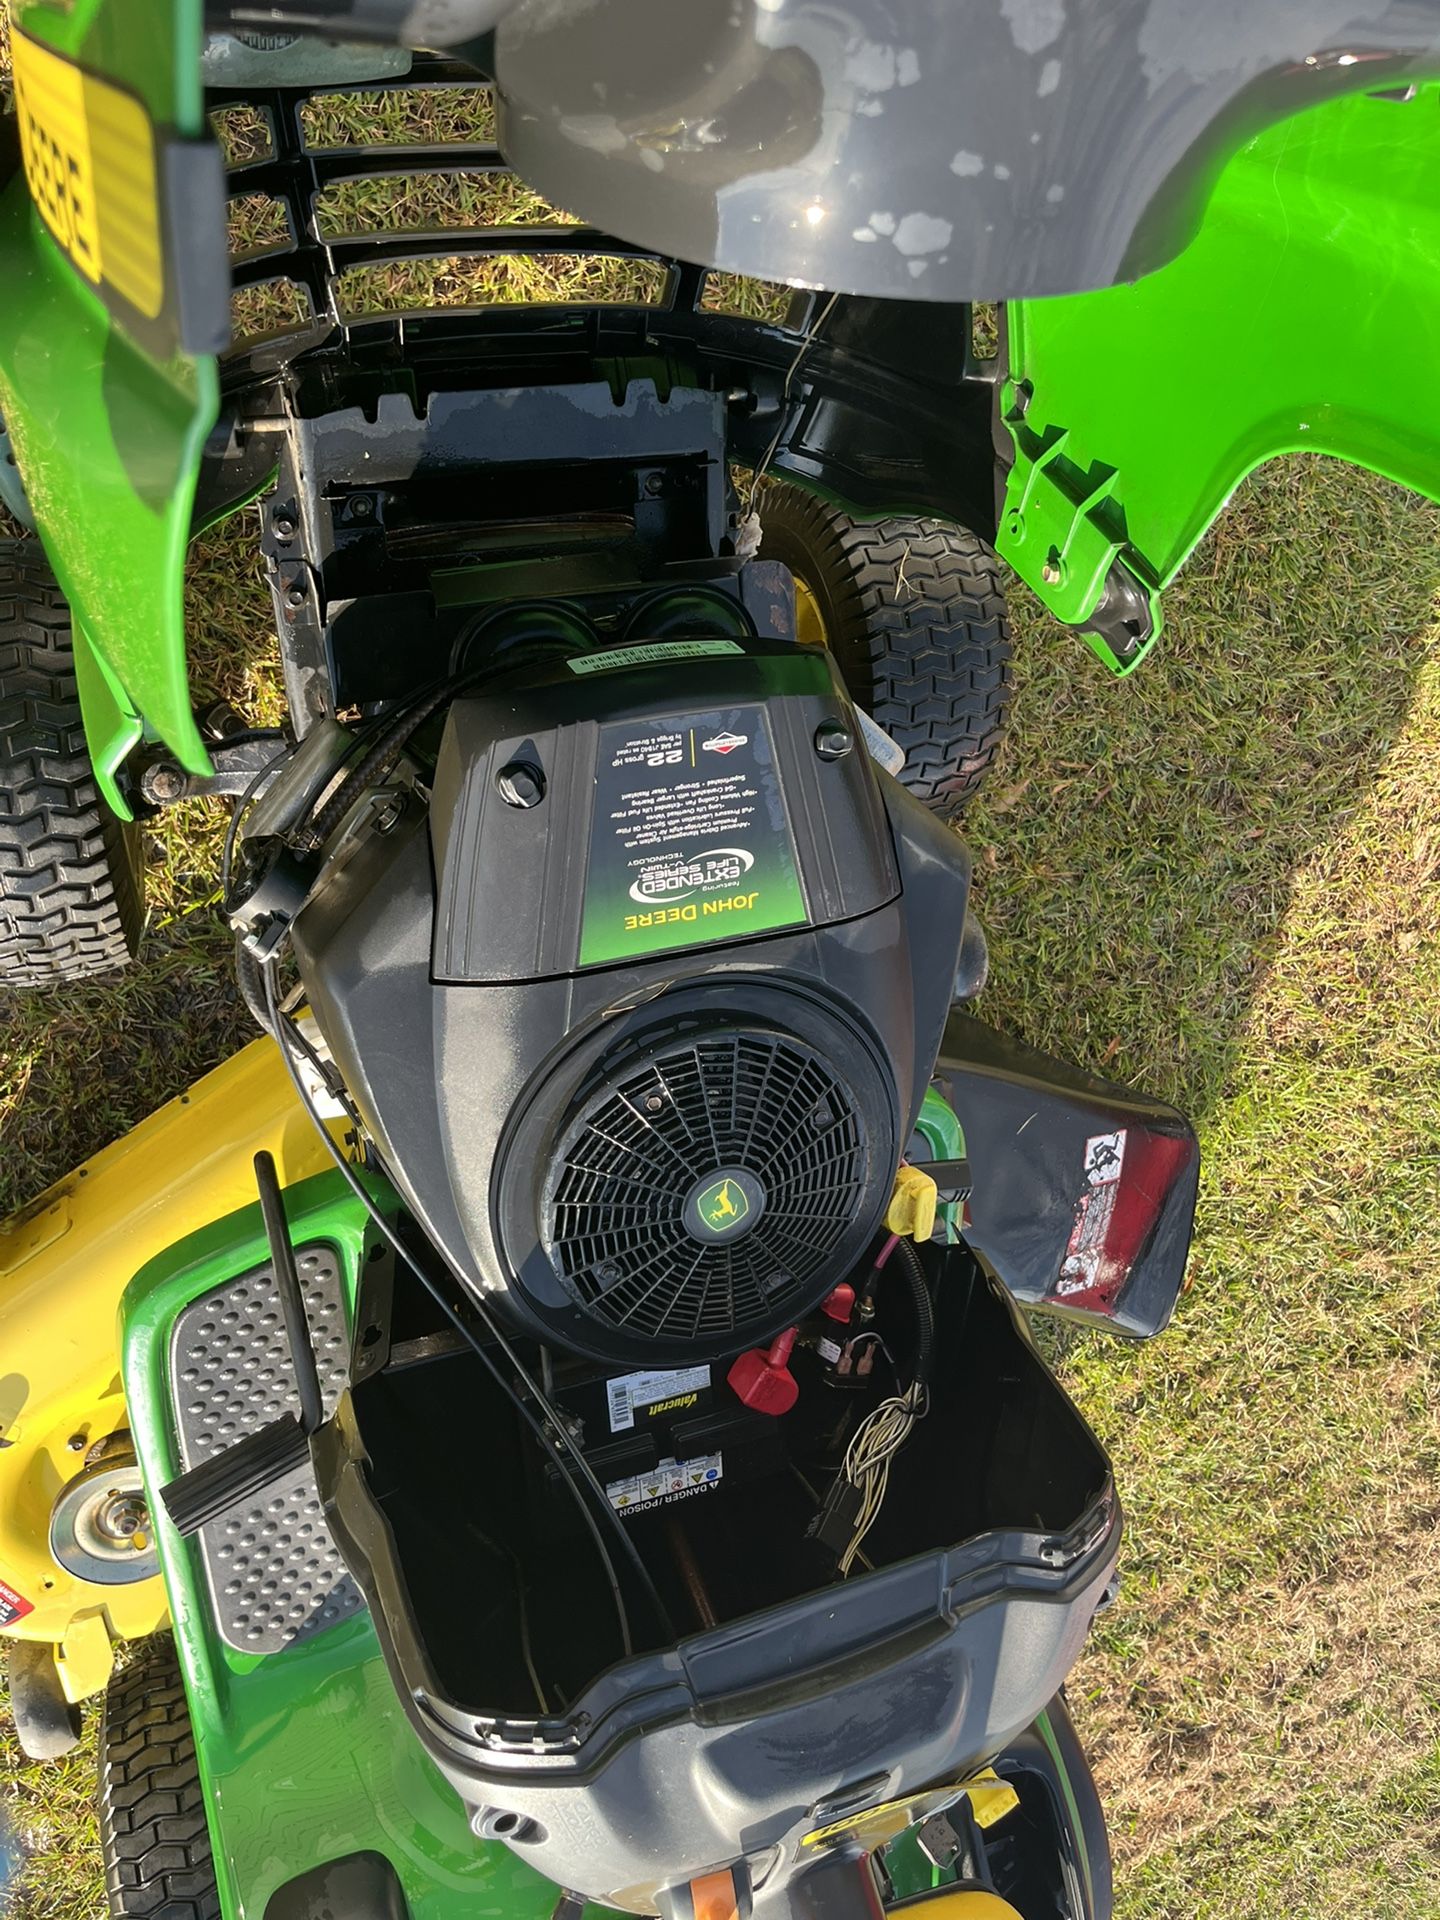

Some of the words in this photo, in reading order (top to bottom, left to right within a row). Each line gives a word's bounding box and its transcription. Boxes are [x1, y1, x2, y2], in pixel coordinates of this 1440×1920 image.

[612, 758, 623, 766] HP
[624, 754, 644, 763] gross
[647, 749, 682, 766] 22
[707, 775, 745, 786] Superfinished
[674, 782, 700, 790] Stronger
[621, 791, 649, 800] Resistant
[691, 787, 723, 797] Crankshaft
[720, 792, 741, 800] Volume
[631, 798, 654, 806] Bearing
[681, 813, 713, 822] Lubrication
[715, 809, 740, 817] Pressure
[642, 821, 666, 830] Spin-On
[713, 817, 737, 825] Premium
[669, 822, 711, 833] Cartridge-style
[636, 831, 657, 839] Cleaner
[639, 835, 661, 844] System
[663, 830, 699, 841] Management
[627, 852, 683, 866] TECHNOLOGY
[706, 857, 739, 870] LIFE
[640, 861, 684, 872] V-TWIN
[642, 864, 701, 881] SERIES
[642, 866, 740, 894] EXTENDED
[702, 881, 739, 891] featuring
[703, 893, 759, 915] JOHN
[625, 905, 696, 929] DEERE
[649, 1393, 697, 1415] Valucraft
[665, 1484, 707, 1503] DANGER
